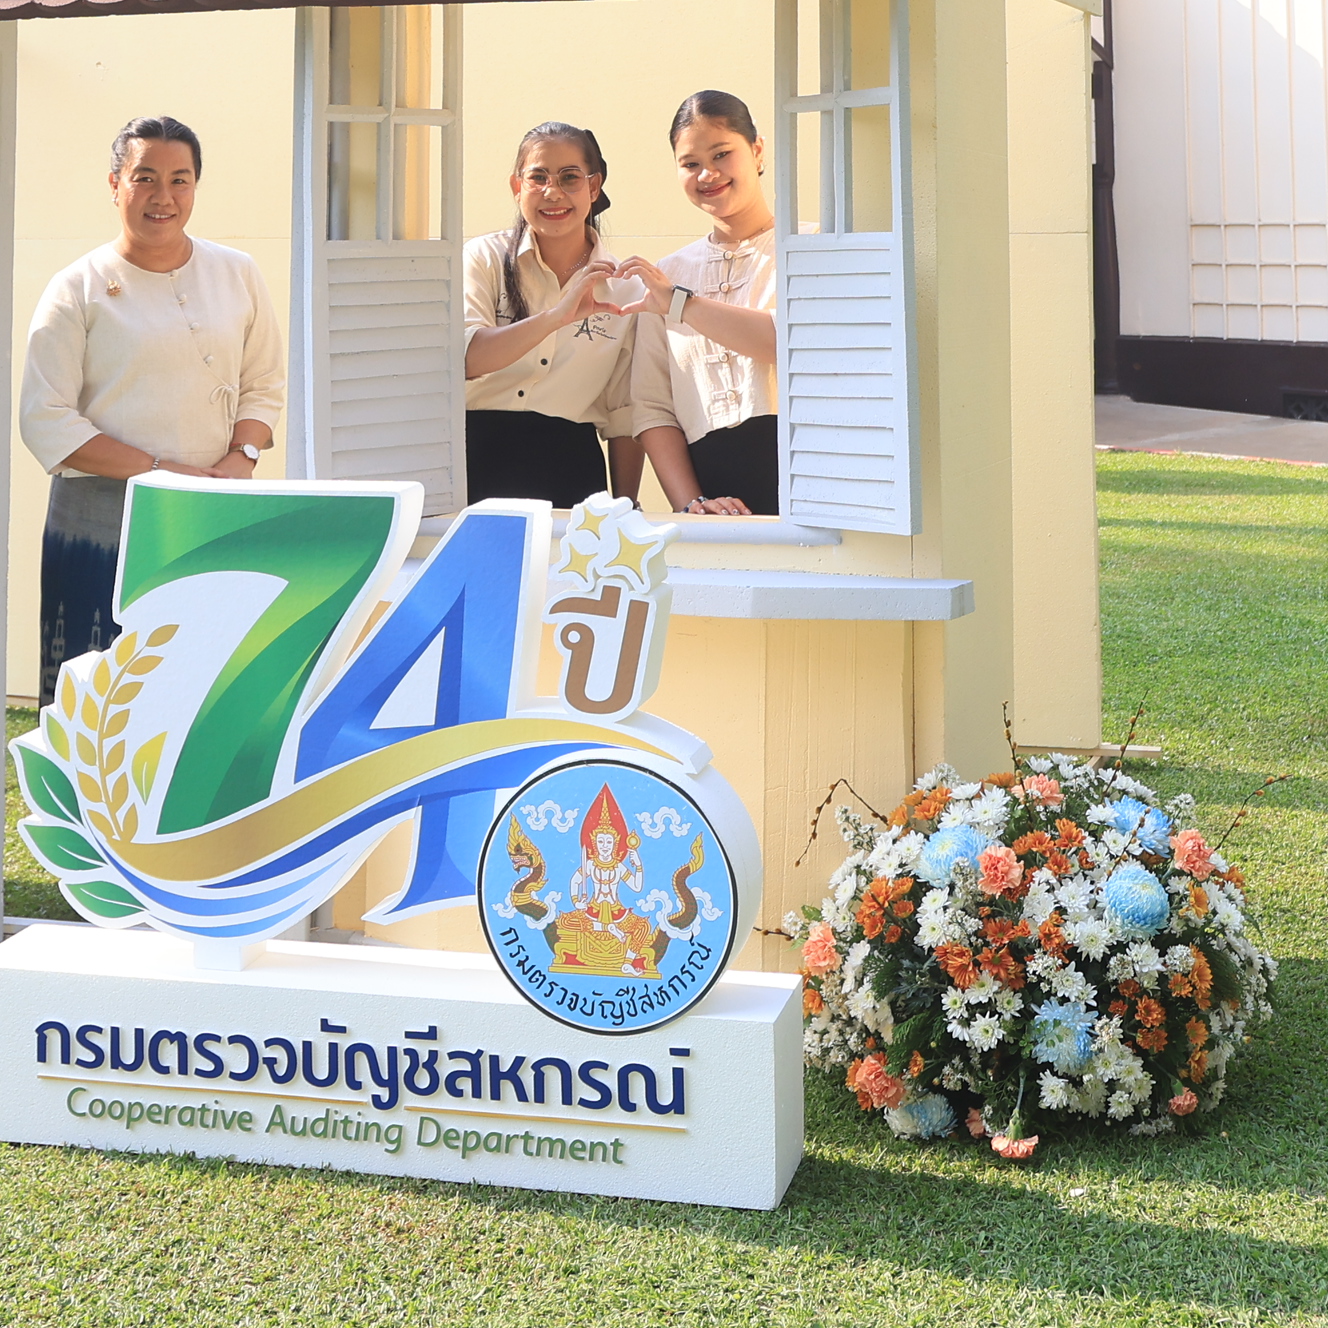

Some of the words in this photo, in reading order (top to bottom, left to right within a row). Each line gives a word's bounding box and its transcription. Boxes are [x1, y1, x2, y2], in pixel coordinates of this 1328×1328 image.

[119, 483, 530, 914] 74
[549, 585, 650, 715] ปี
[499, 925, 713, 1026] กรมตรวจบัญชีสหกรณ์
[35, 1018, 691, 1115] กรมตรวจบัญชีสหกรณ์
[67, 1086, 255, 1134] Cooperative
[264, 1105, 405, 1155] Auditing
[415, 1116, 625, 1166] Department
